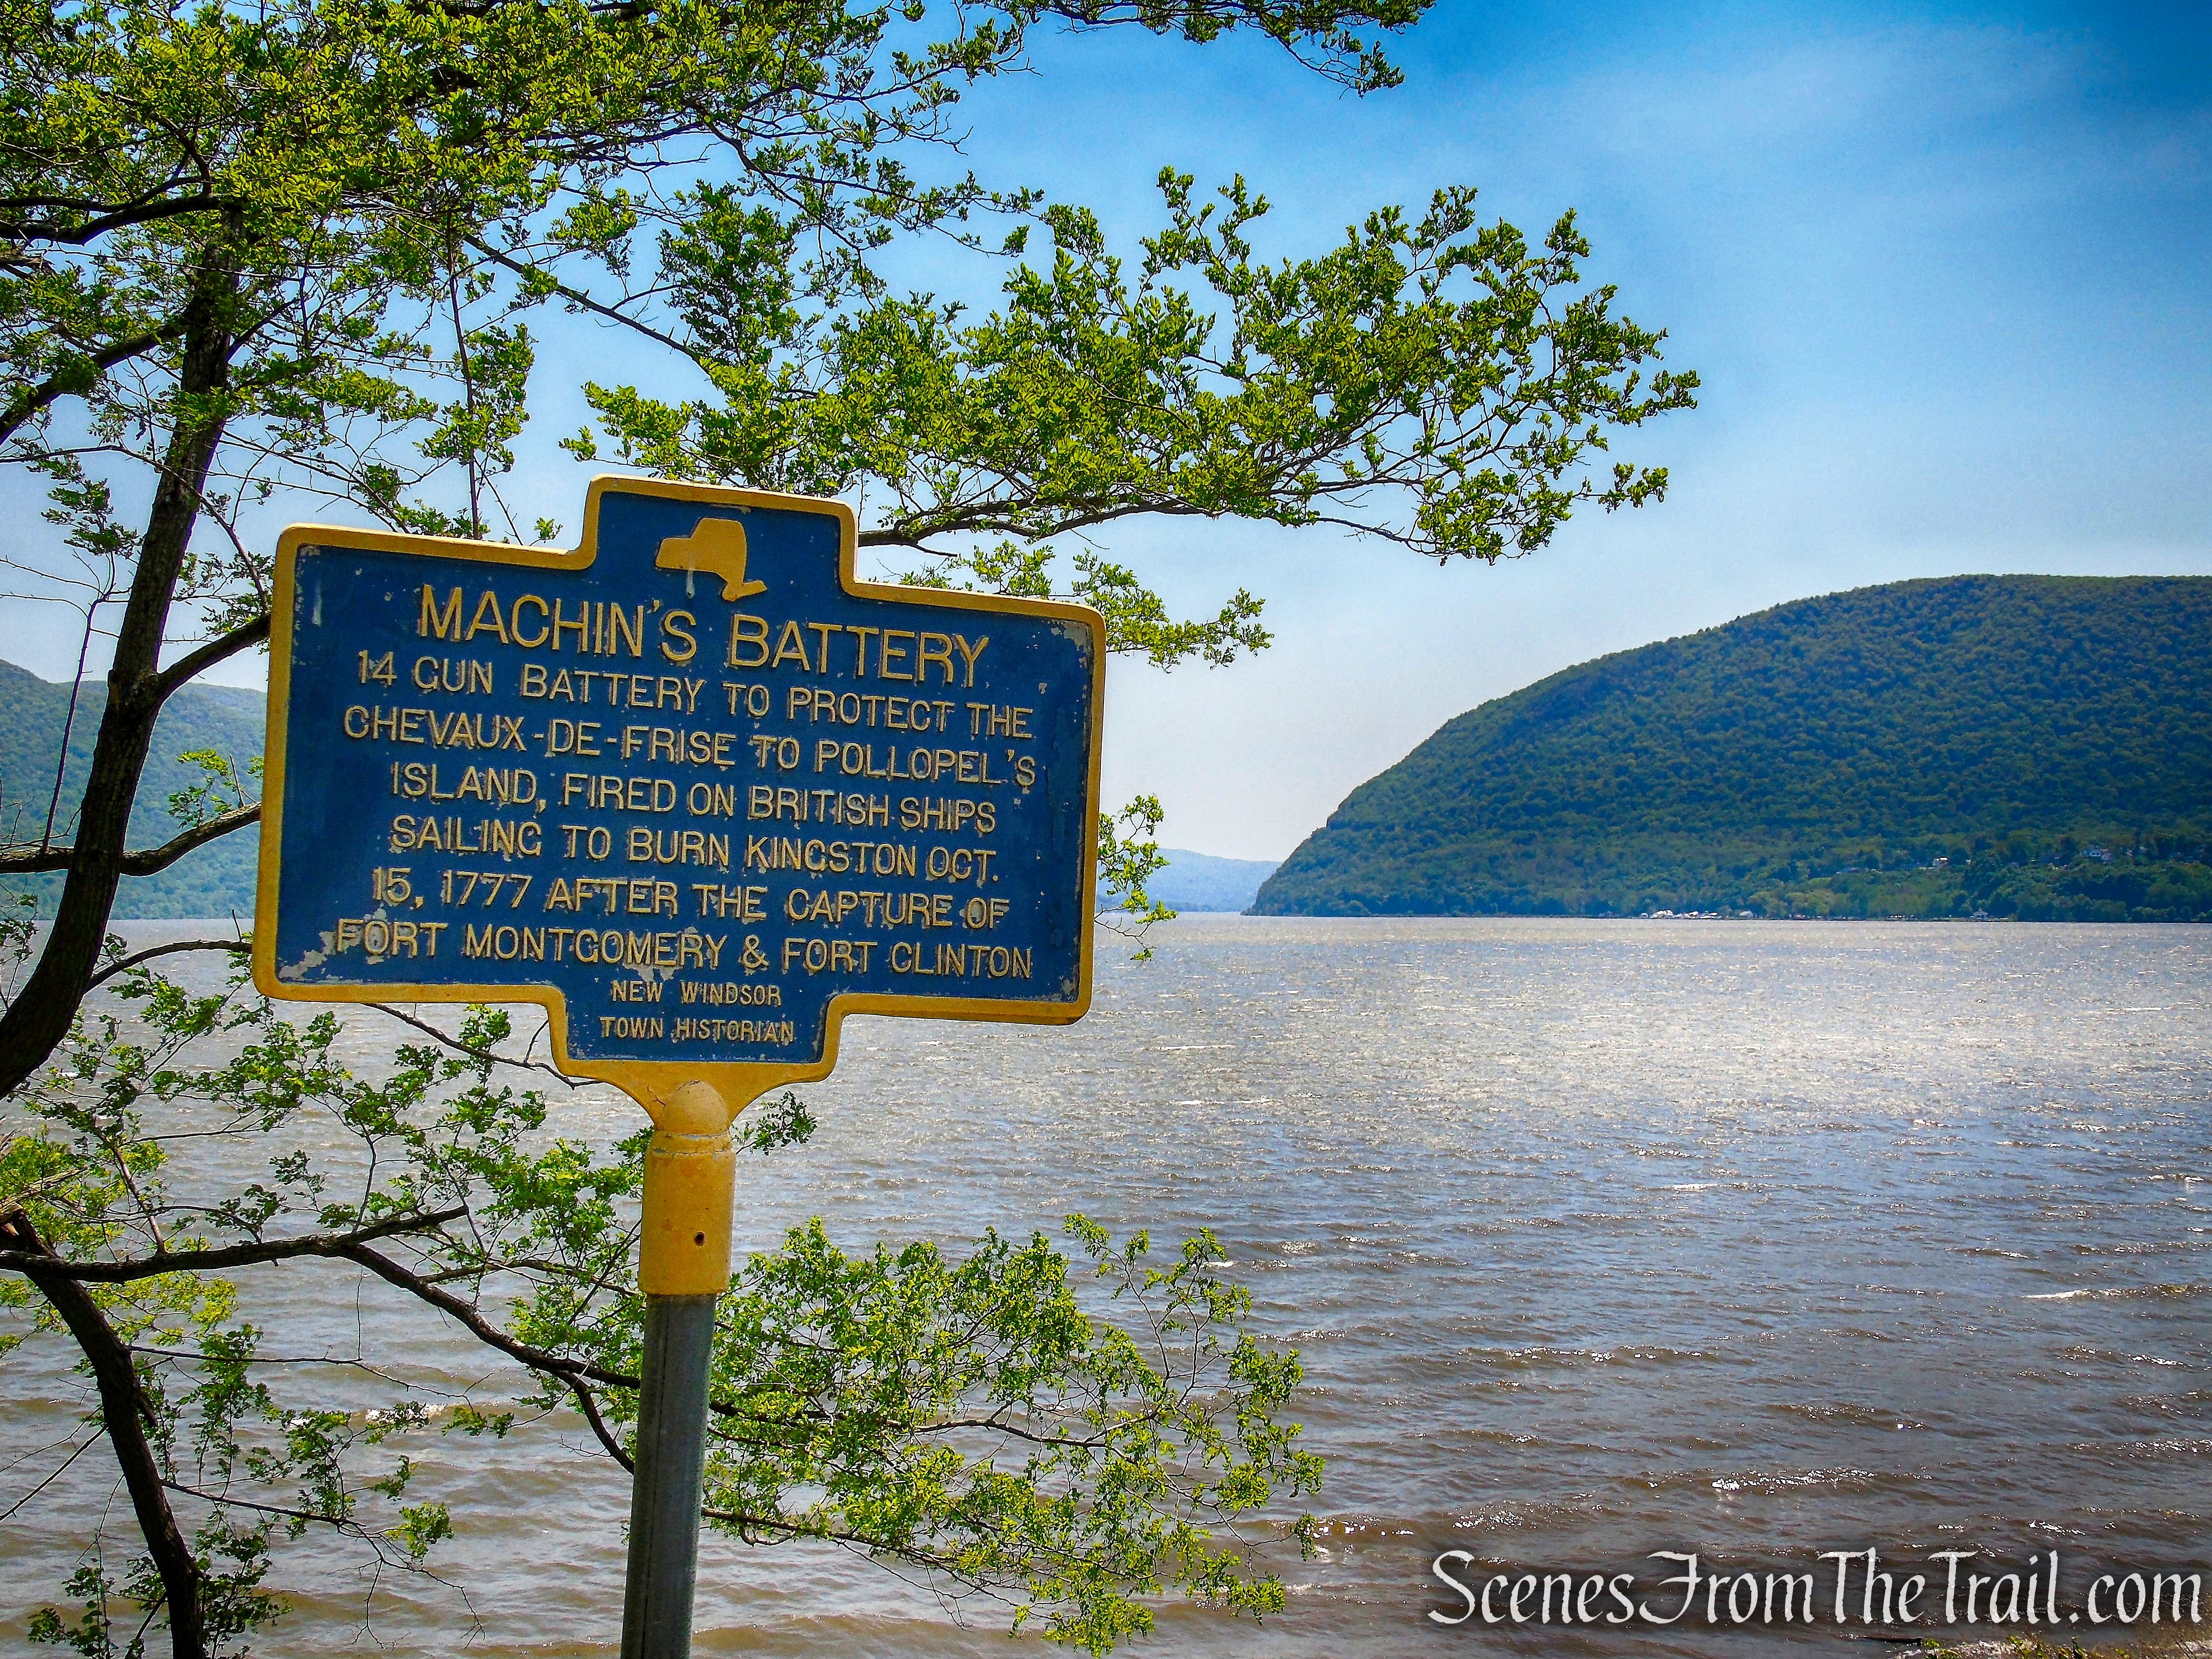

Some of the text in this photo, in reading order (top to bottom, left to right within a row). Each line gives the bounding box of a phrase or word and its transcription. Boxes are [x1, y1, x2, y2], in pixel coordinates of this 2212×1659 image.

[418, 584, 989, 687] MACHIN'S BATTERY
[358, 650, 1033, 738] 14 GUN BATTERY TO PROTECT THE
[751, 734, 800, 770] TO
[815, 740, 1035, 786] POLLOPEL'S
[392, 762, 996, 833] ISLAND, FIRED ON BRITISH SHIPS
[391, 814, 998, 882] SAILING TO BURN KINGSTON OCT.
[373, 867, 1010, 929] 15, 1777 AFTER THE CAPTURE OF
[335, 918, 1032, 978] FORT MONTGOMERY & FORT CLINTON
[611, 980, 781, 1006] NEW WINDSOR
[600, 1016, 793, 1043] TOWN HISTORIAN
